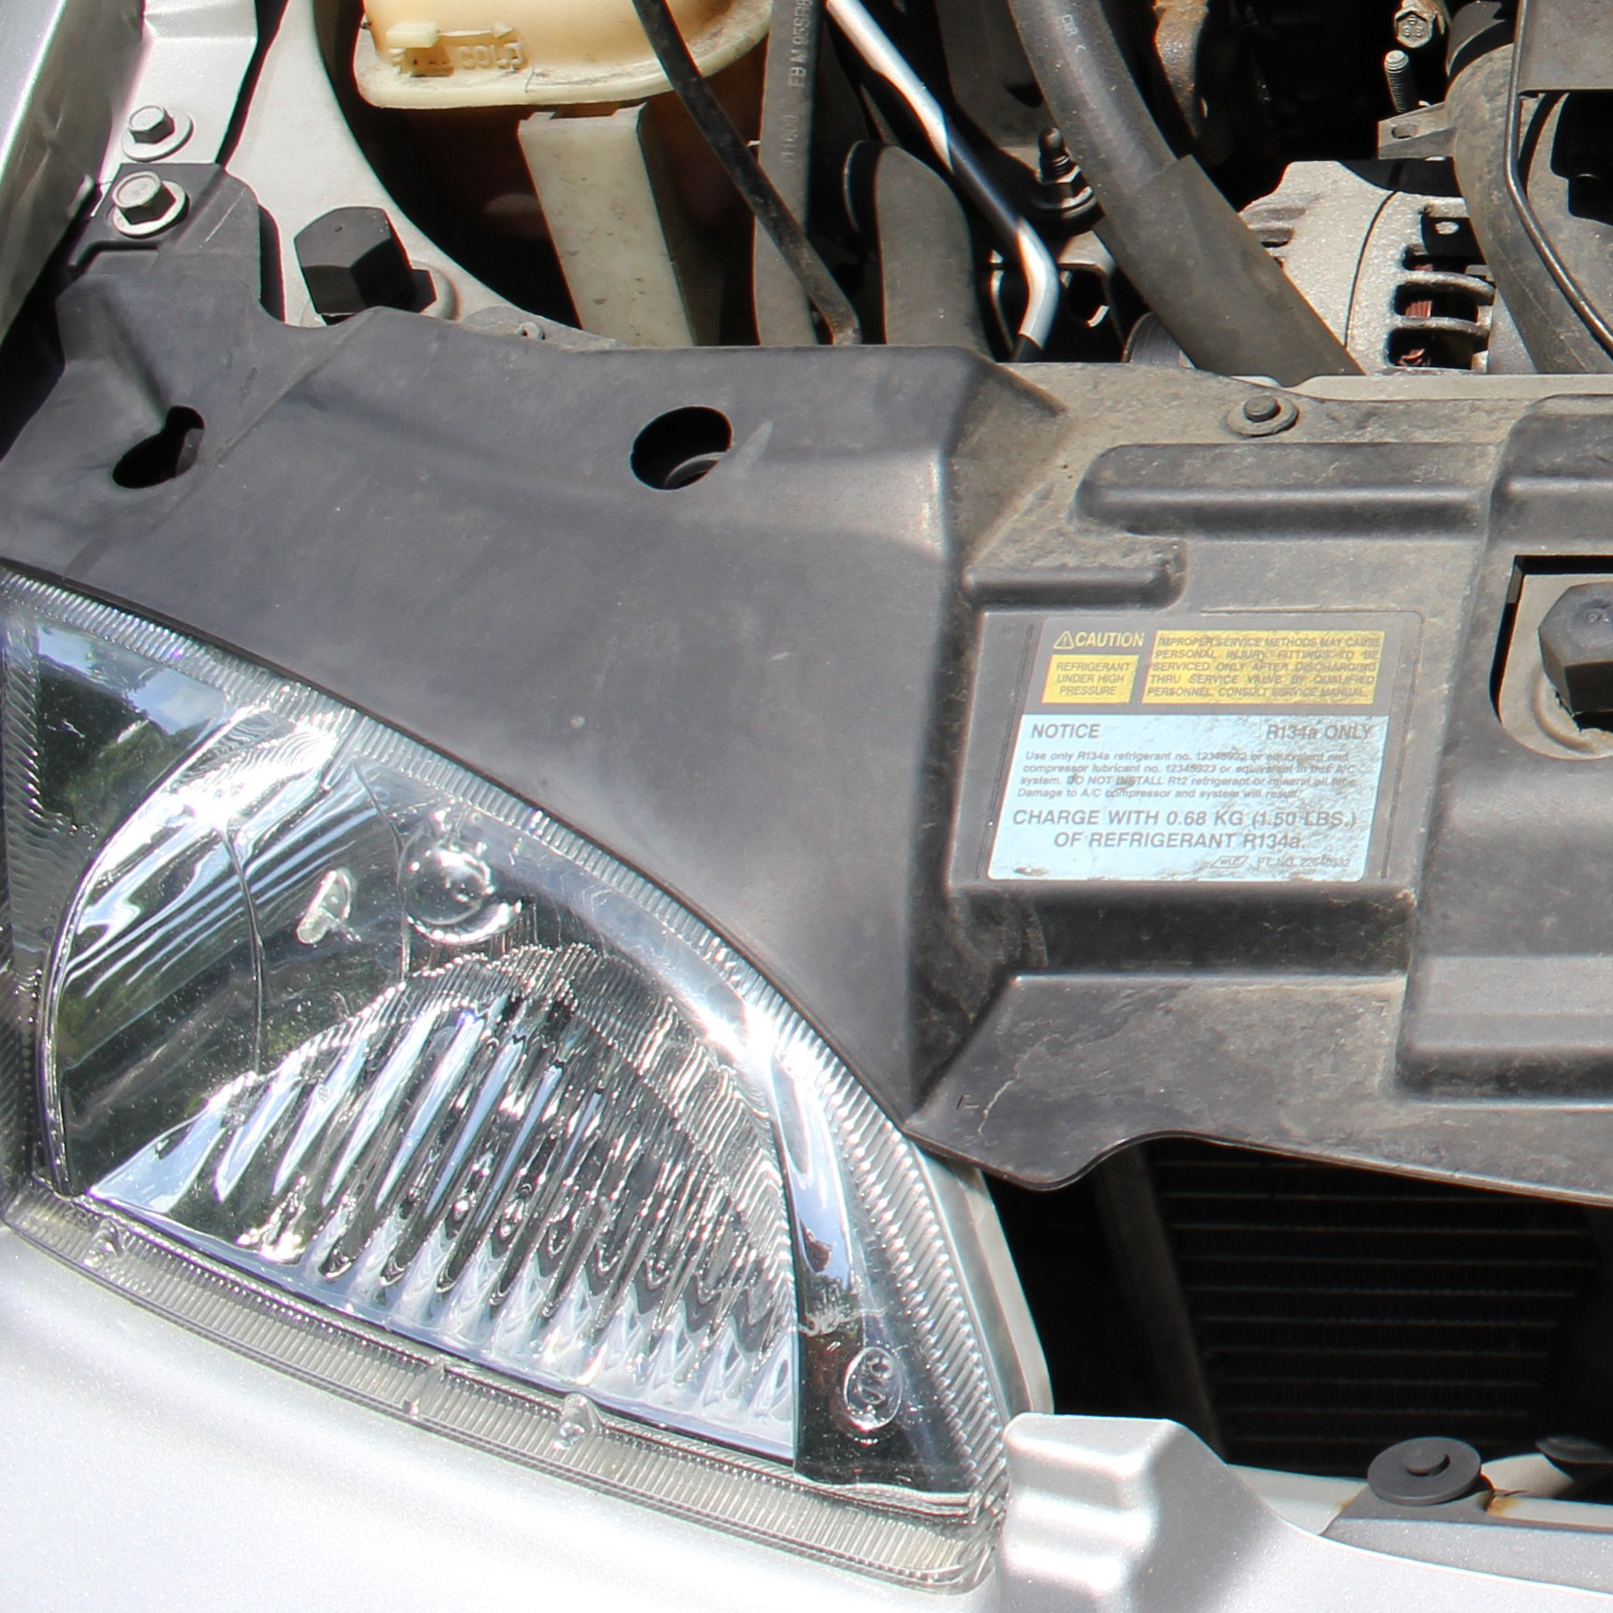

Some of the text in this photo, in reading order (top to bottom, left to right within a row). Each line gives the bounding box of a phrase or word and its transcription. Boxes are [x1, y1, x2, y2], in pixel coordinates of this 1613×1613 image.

[1075, 632, 1145, 648] CAUTION
[1056, 662, 1131, 672] REFRIGERANT
[1057, 674, 1125, 684] UNDER HIGH
[1059, 686, 1116, 695] PRESSURE
[1031, 723, 1373, 739] NOTICE R134a ONLY
[1026, 751, 1046, 760] Use
[1050, 751, 1074, 762] only
[1077, 751, 1110, 760] R134a
[1114, 751, 1171, 762] refrigerant
[1175, 753, 1192, 761] no.
[1023, 766, 1088, 774] compressor
[1092, 763, 1140, 773] lubricant
[1020, 777, 1062, 787] system.
[1088, 776, 1113, 785] NOT
[1116, 776, 1163, 785] INSTALL
[1168, 776, 1188, 785] R12
[1018, 788, 1261, 799] Damage to A/C compressor and system will
[1012, 809, 1357, 829] CHARGE WITH 0.68 KG (1.50 LBS.)
[1053, 832, 1083, 848] OF
[1089, 831, 1236, 849] REFRIGERANT
